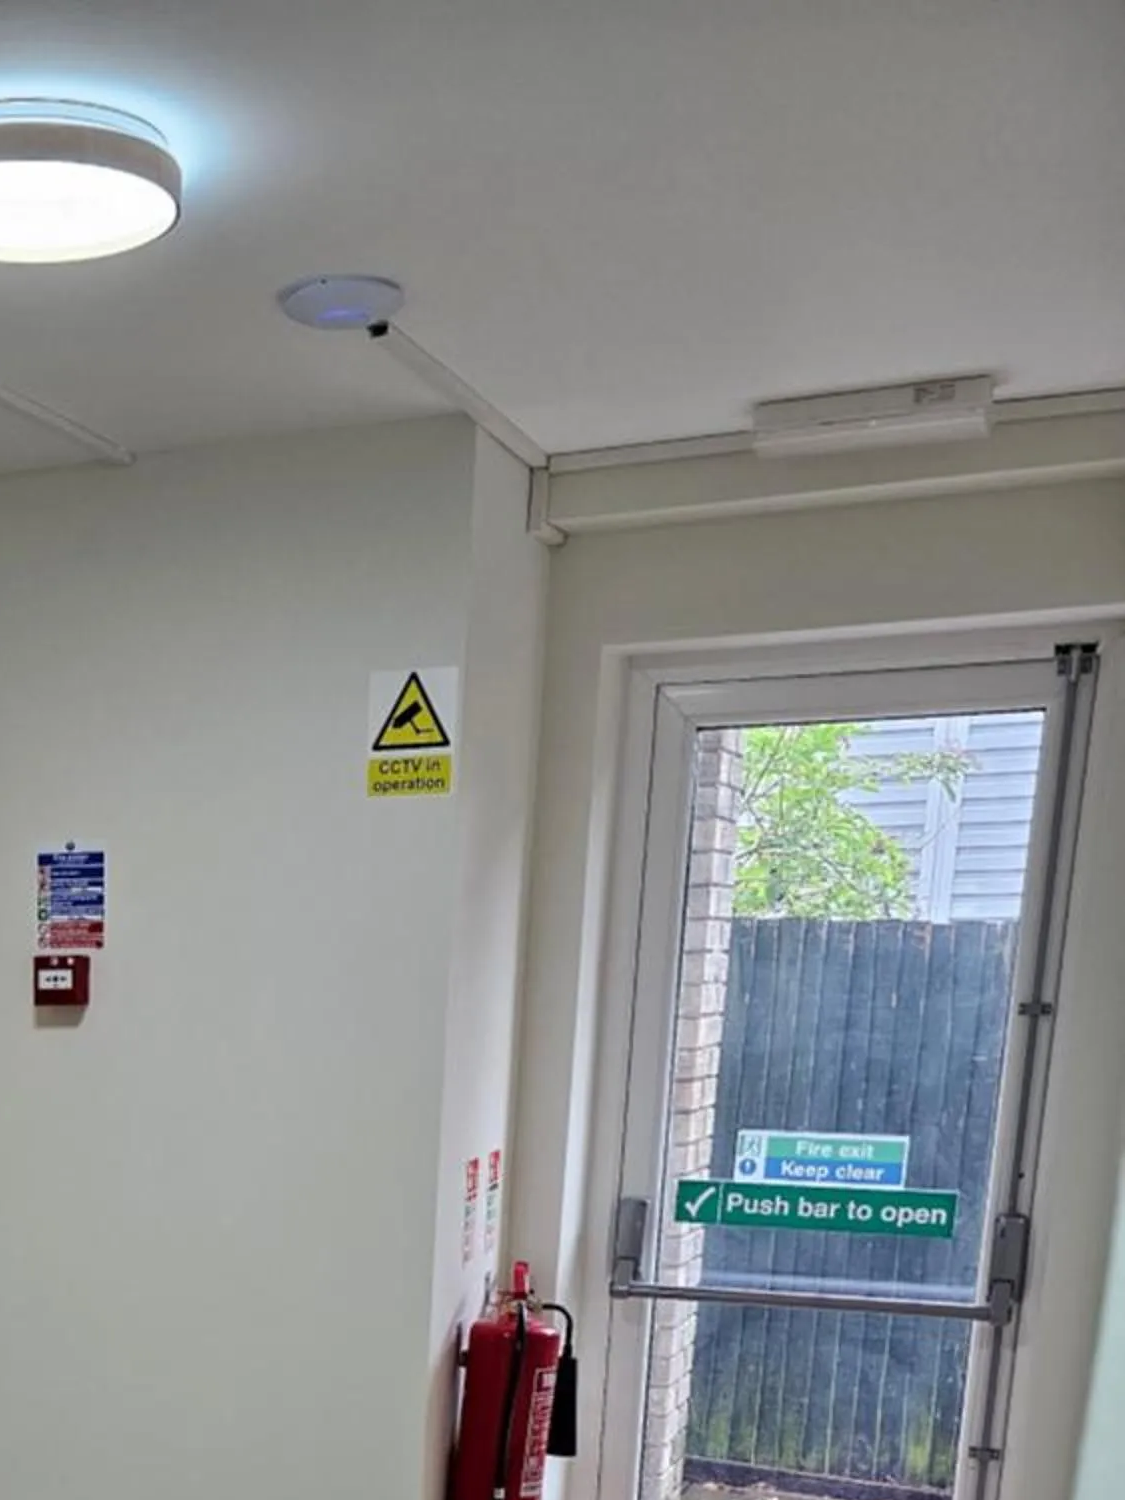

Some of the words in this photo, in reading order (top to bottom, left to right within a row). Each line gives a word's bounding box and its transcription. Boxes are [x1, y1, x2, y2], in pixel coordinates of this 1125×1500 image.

[378, 758, 423, 775] CCTV
[426, 758, 441, 772] in
[373, 776, 445, 792] operation
[795, 1140, 833, 1157] Fire
[838, 1141, 874, 1160] exit
[780, 1160, 829, 1181] Keep
[835, 1164, 885, 1181] clear
[725, 1192, 789, 1216] Push
[797, 1196, 837, 1219] bar
[845, 1200, 873, 1221] to
[879, 1206, 948, 1228] open
